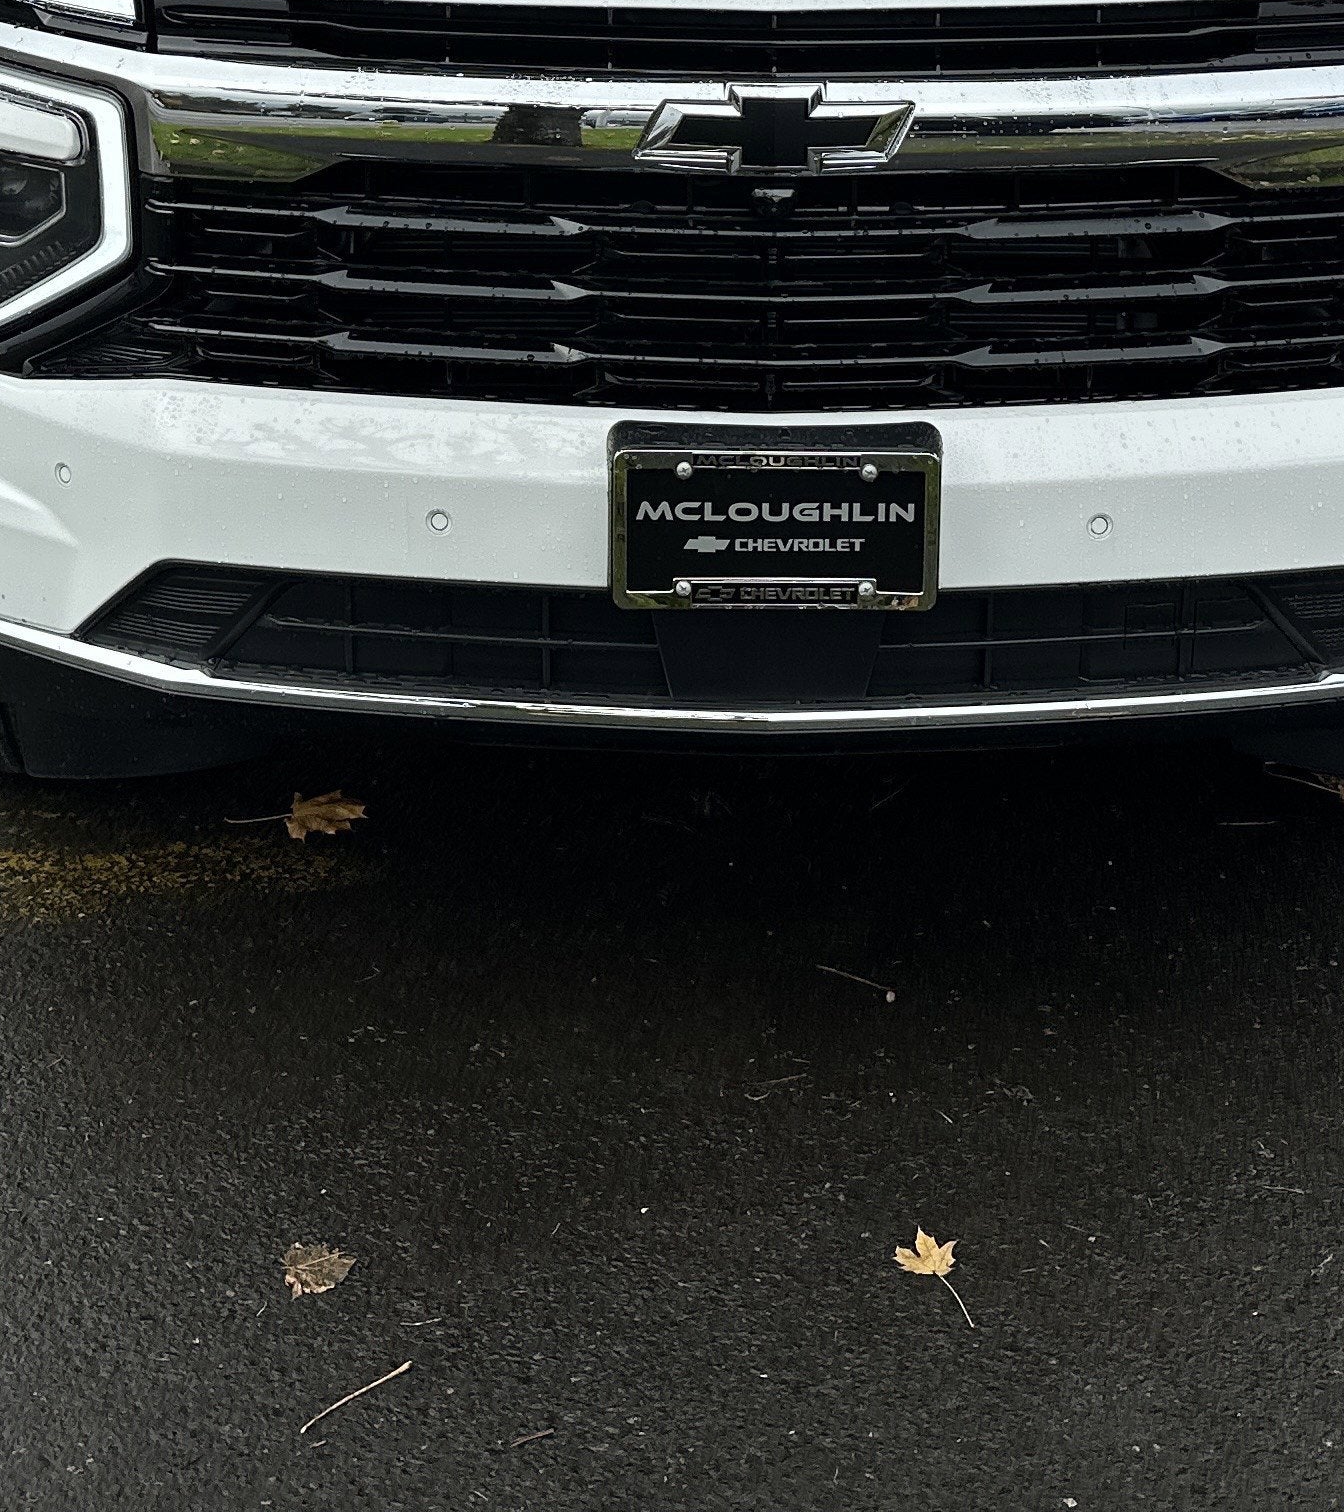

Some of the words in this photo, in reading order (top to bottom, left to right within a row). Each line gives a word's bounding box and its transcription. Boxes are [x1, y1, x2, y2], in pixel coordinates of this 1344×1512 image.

[696, 455, 859, 467] MCLOUGHLIN
[635, 500, 916, 523] MCLOUGHLIN
[734, 538, 865, 552] CHEVROLET
[740, 586, 855, 601] CHEVROLET
